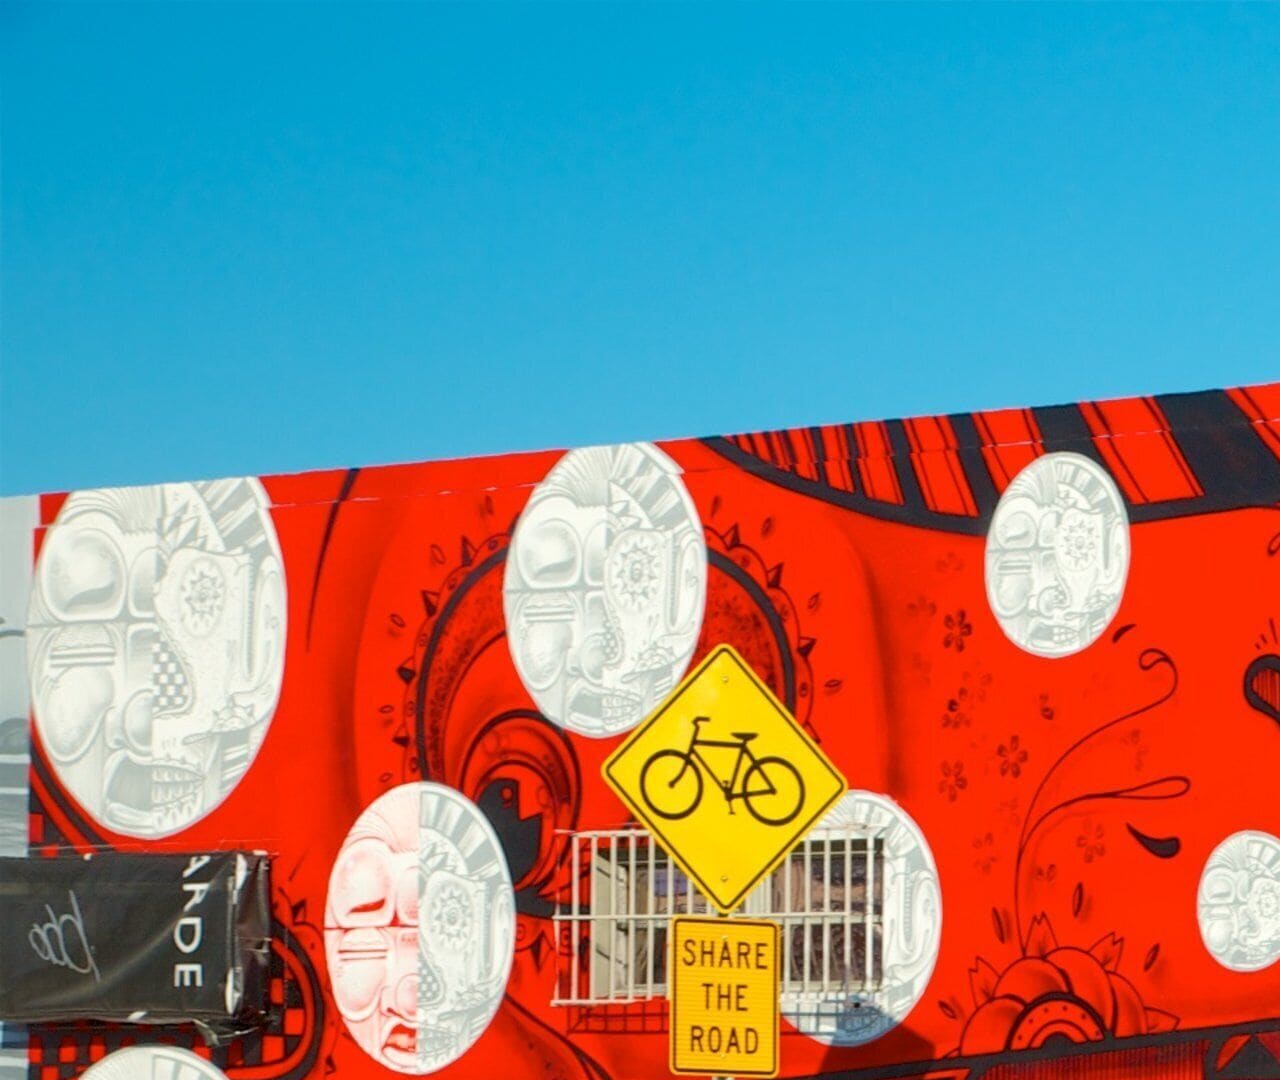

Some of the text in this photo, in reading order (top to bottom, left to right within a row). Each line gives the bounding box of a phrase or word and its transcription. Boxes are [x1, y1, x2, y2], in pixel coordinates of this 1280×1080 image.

[682, 938, 769, 970] SHARE
[701, 982, 749, 1012] THE
[689, 1025, 760, 1055] ROAD
